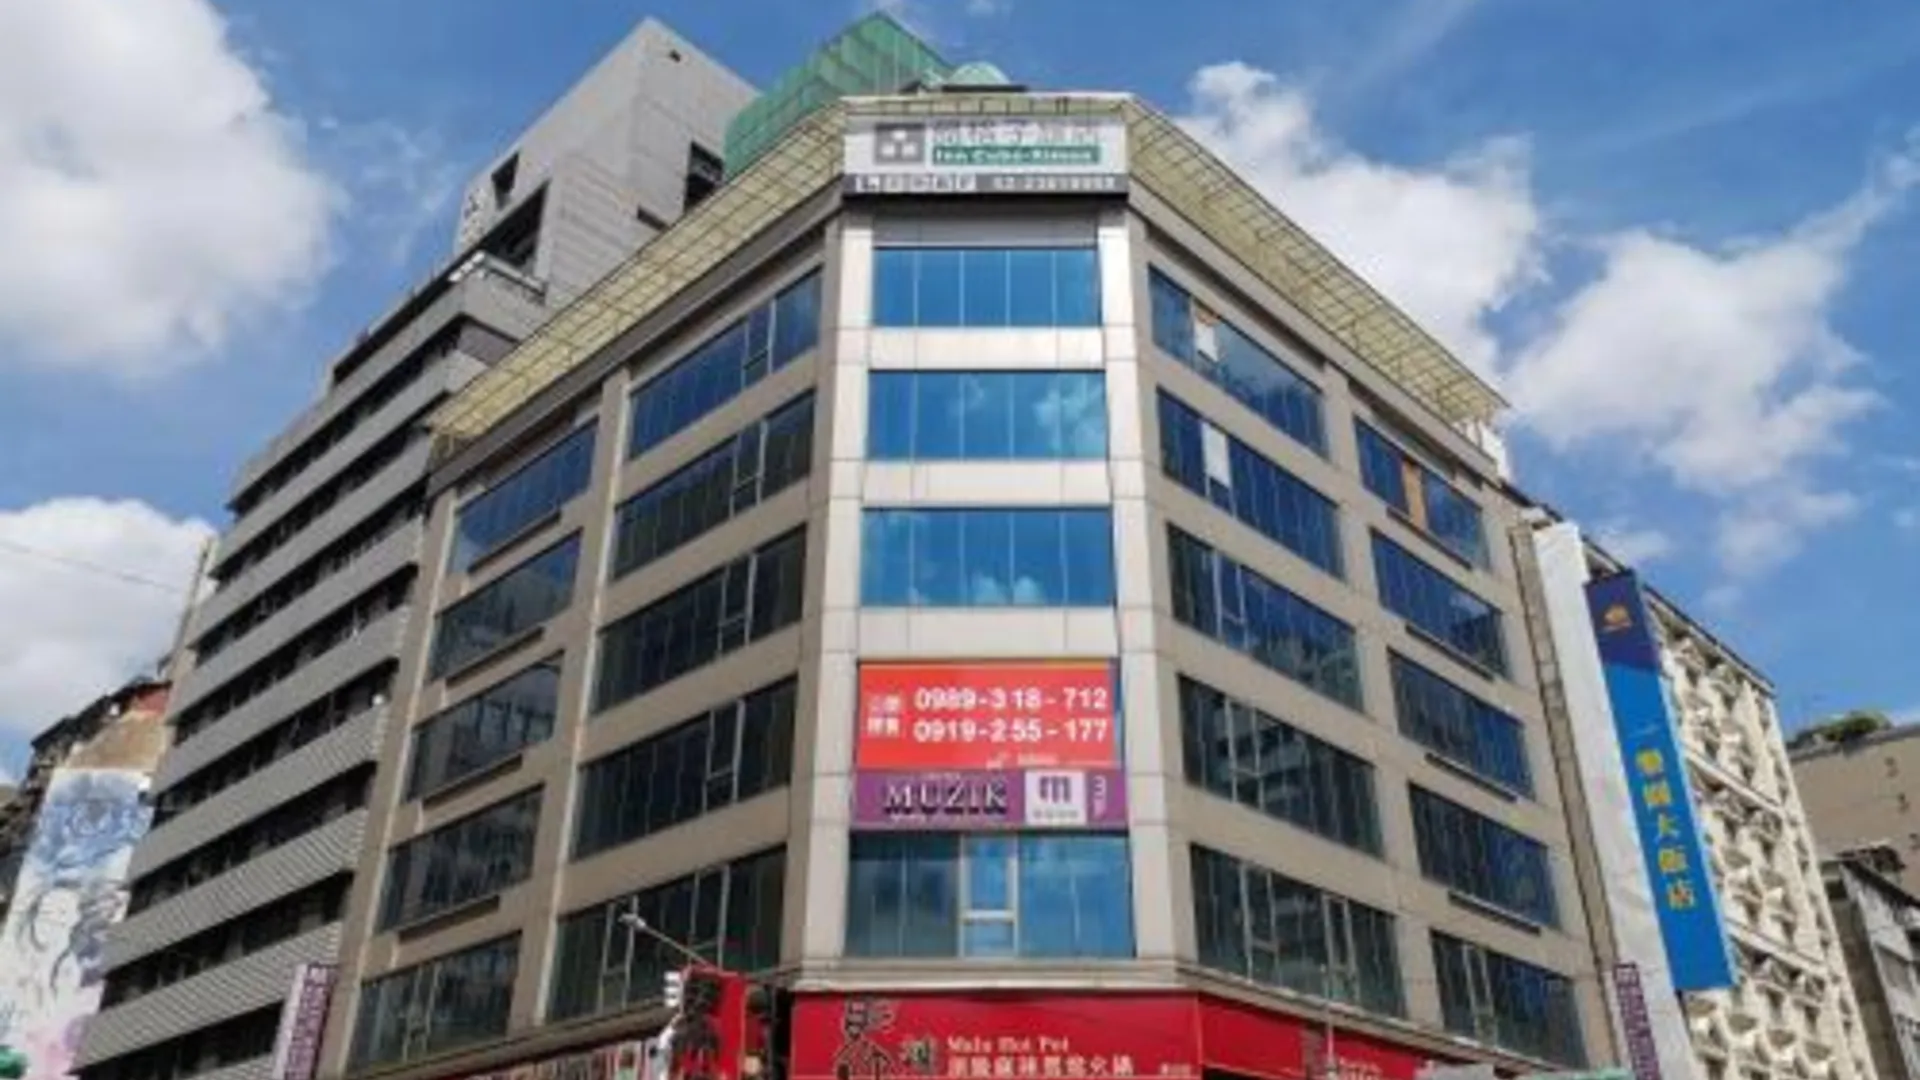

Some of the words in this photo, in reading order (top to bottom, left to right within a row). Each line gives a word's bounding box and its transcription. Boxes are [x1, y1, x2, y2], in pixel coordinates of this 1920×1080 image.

[912, 718, 1108, 743] 0919-255-177
[884, 778, 1008, 815] MUZIK
[998, 1036, 1031, 1053] Hot
[1038, 1036, 1070, 1053] Pot
